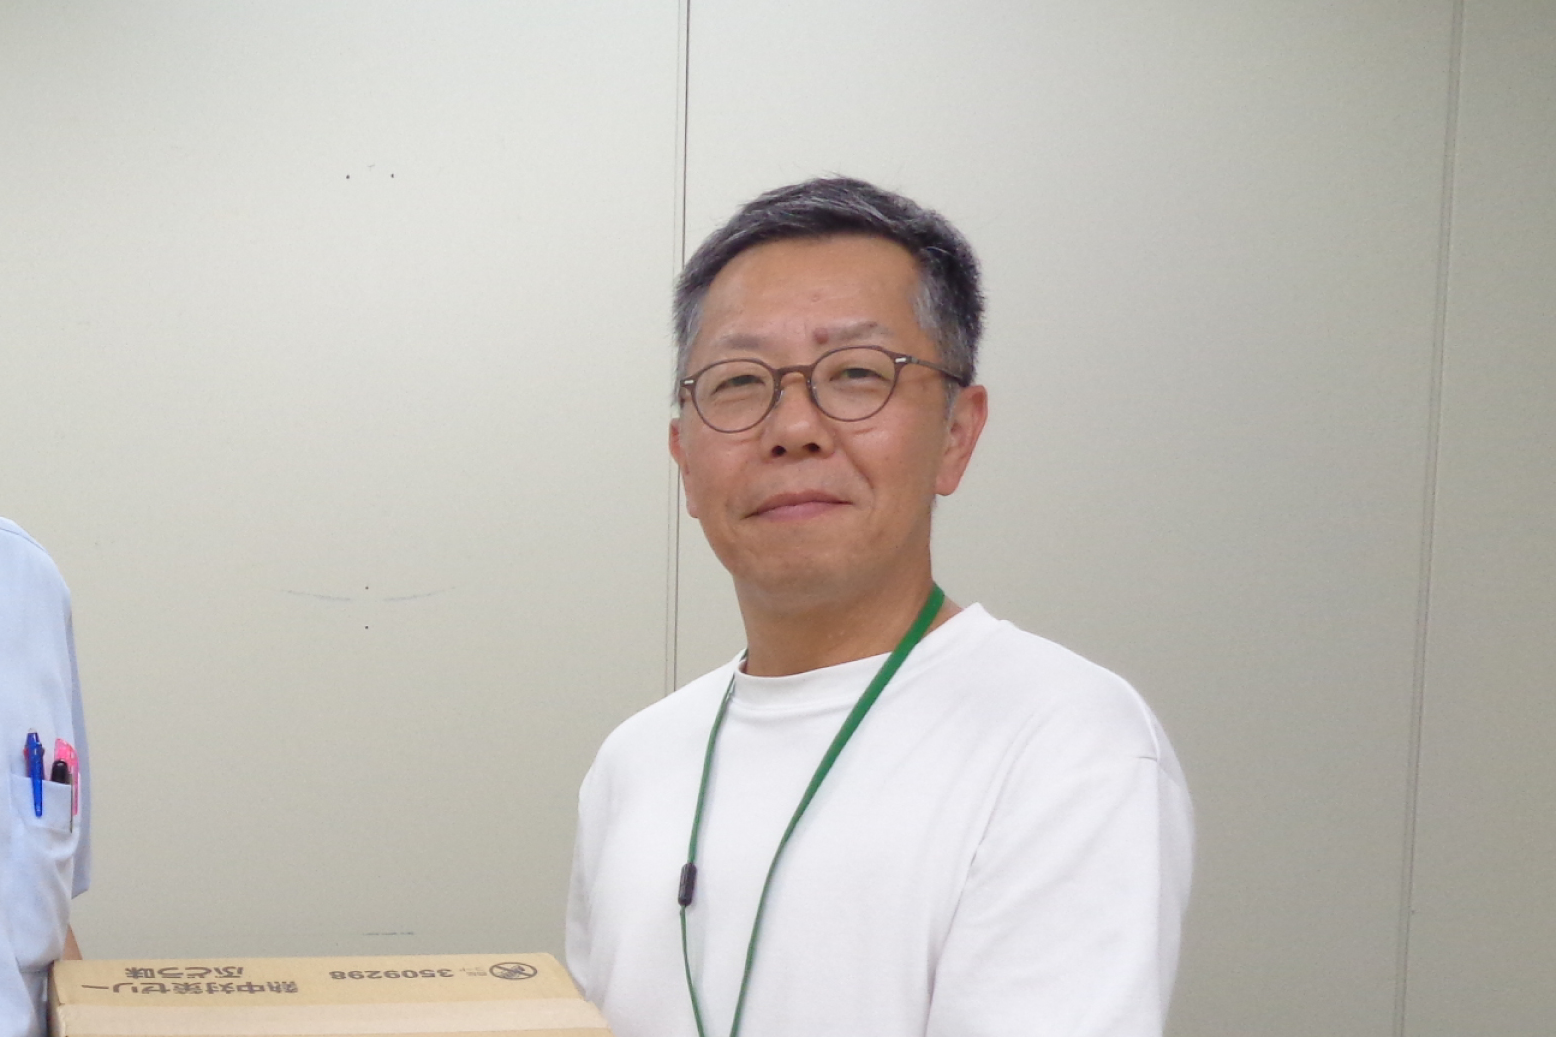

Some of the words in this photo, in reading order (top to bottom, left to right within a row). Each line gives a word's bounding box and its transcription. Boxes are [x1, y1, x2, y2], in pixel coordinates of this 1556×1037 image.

[125, 966, 244, 981] ぶどう味
[330, 968, 454, 980] 3509298
[81, 980, 298, 996] 熱中対策ゼリー
